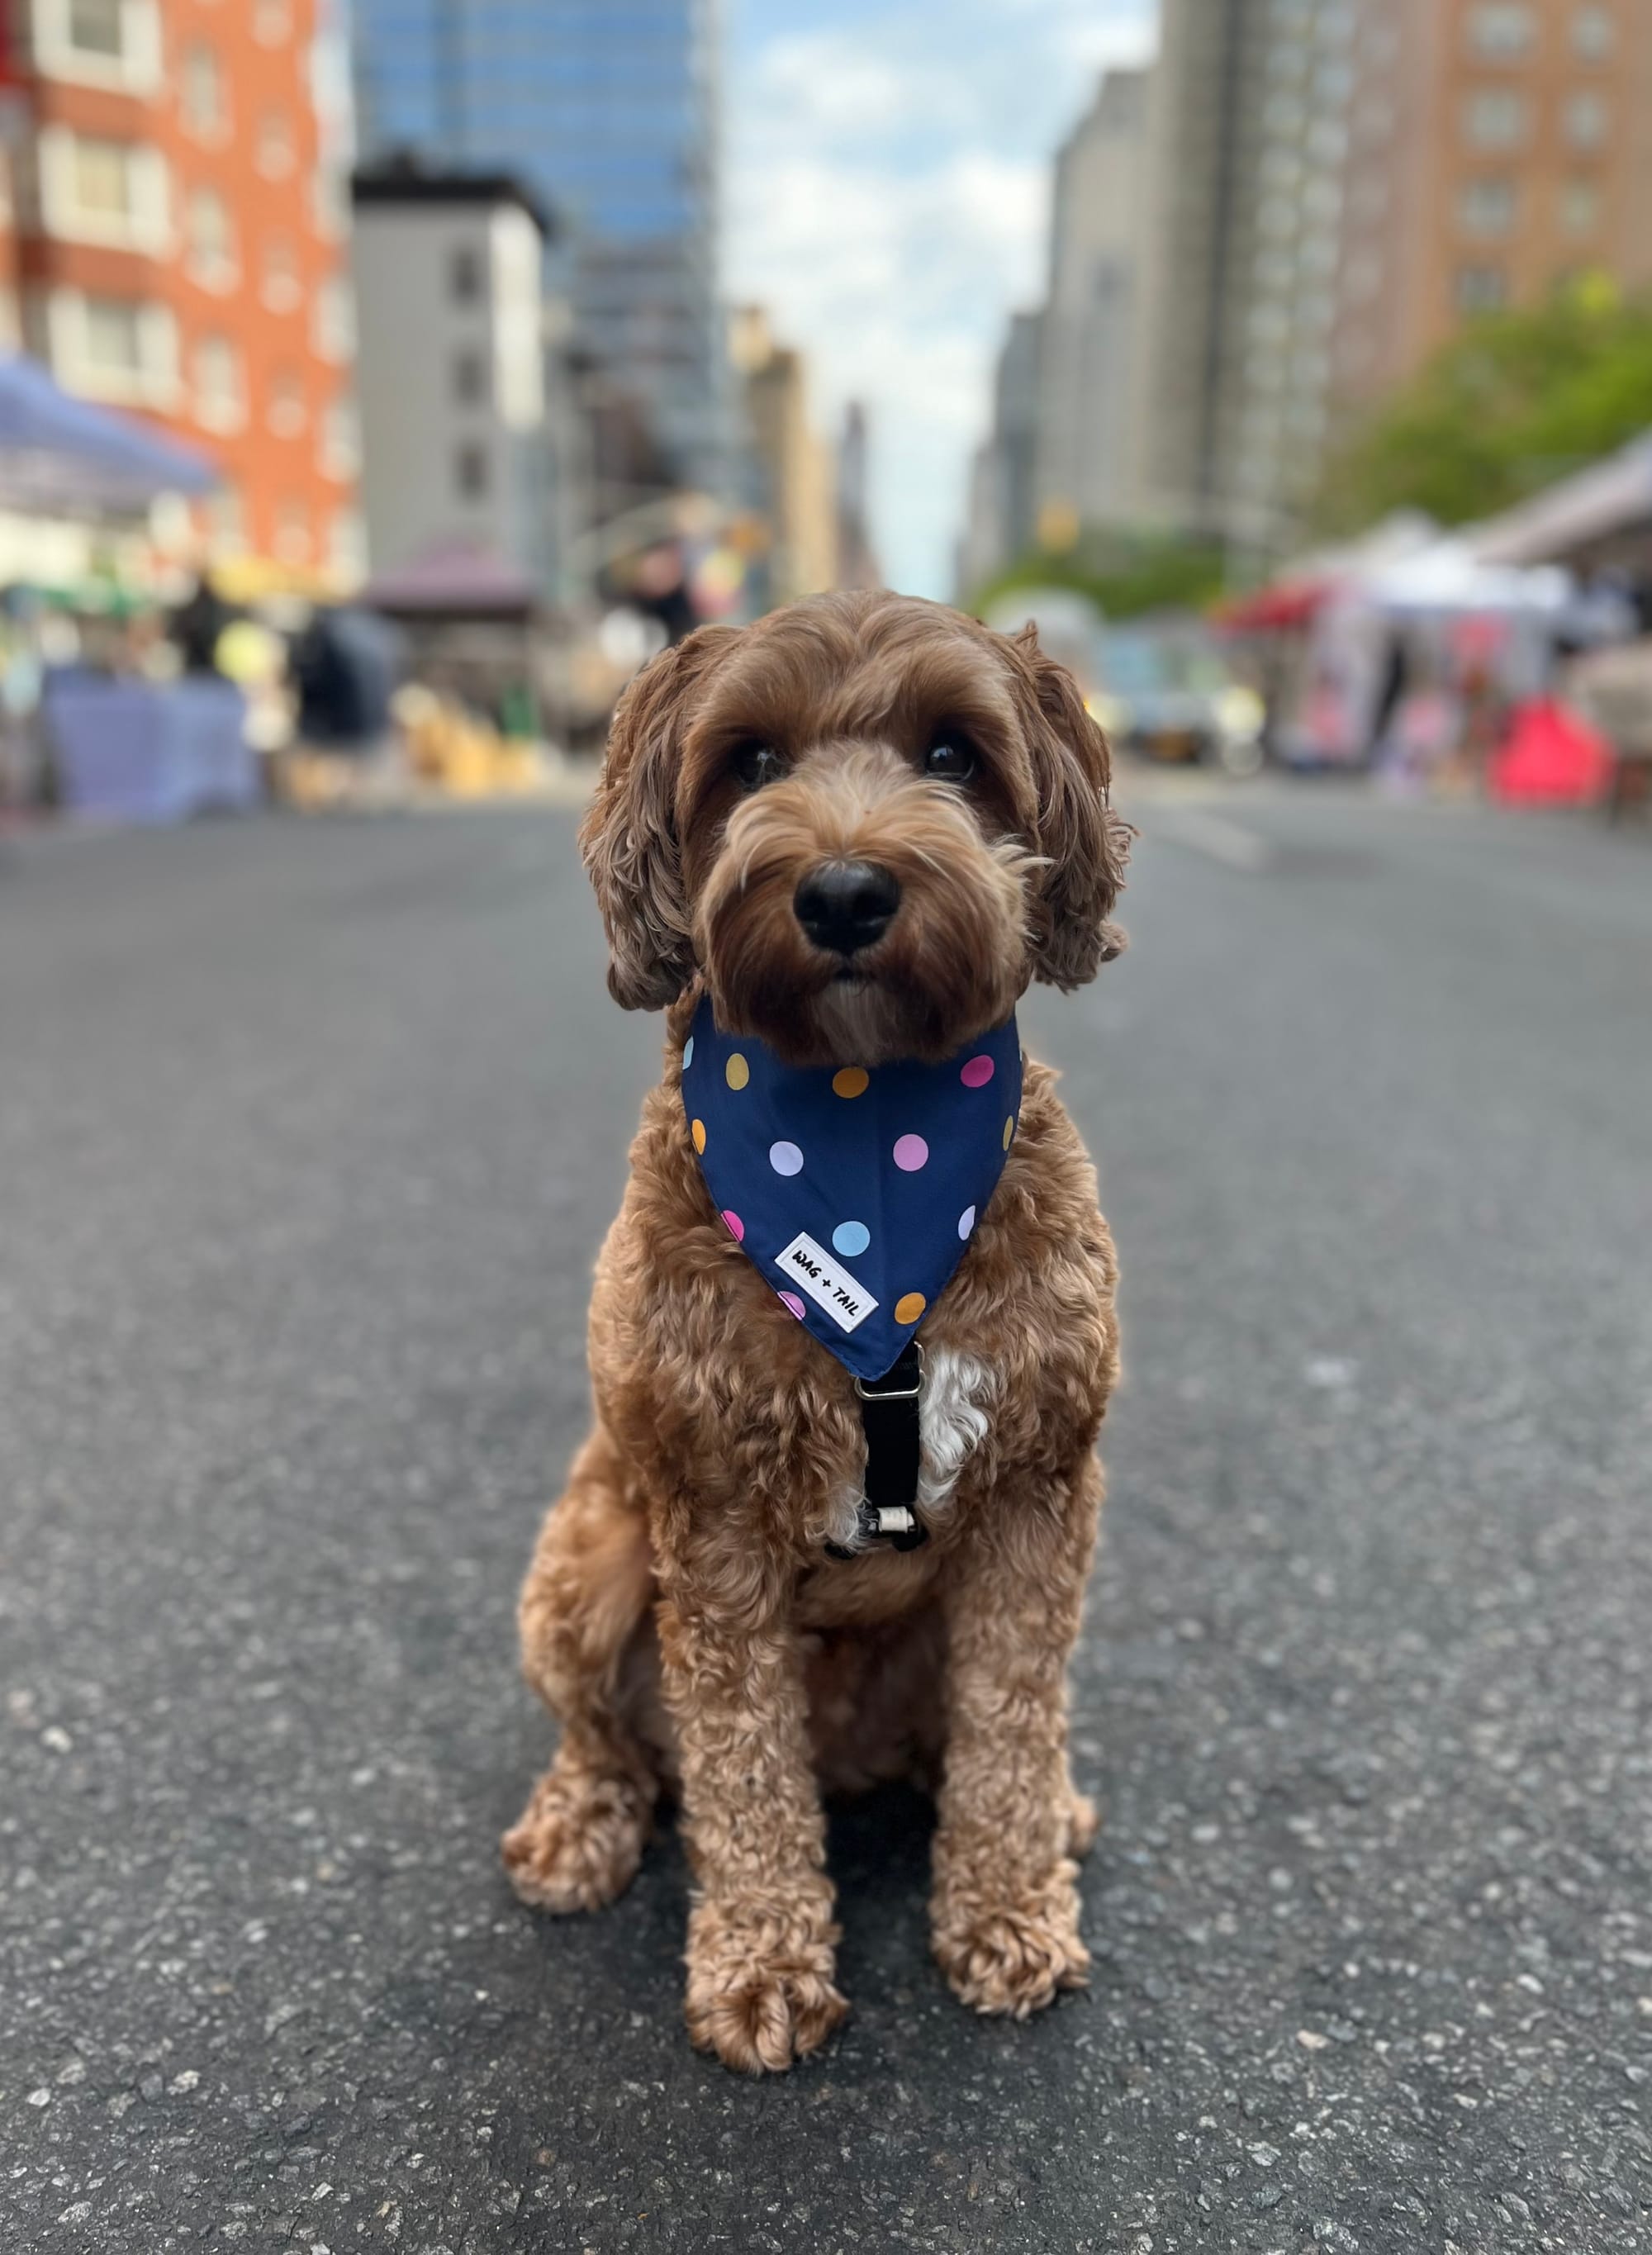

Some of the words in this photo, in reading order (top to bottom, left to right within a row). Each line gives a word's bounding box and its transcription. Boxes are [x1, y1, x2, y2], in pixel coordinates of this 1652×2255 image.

[792, 1250, 822, 1279] WAG
[822, 1279, 832, 1288] +
[833, 1287, 859, 1317] TAIL
